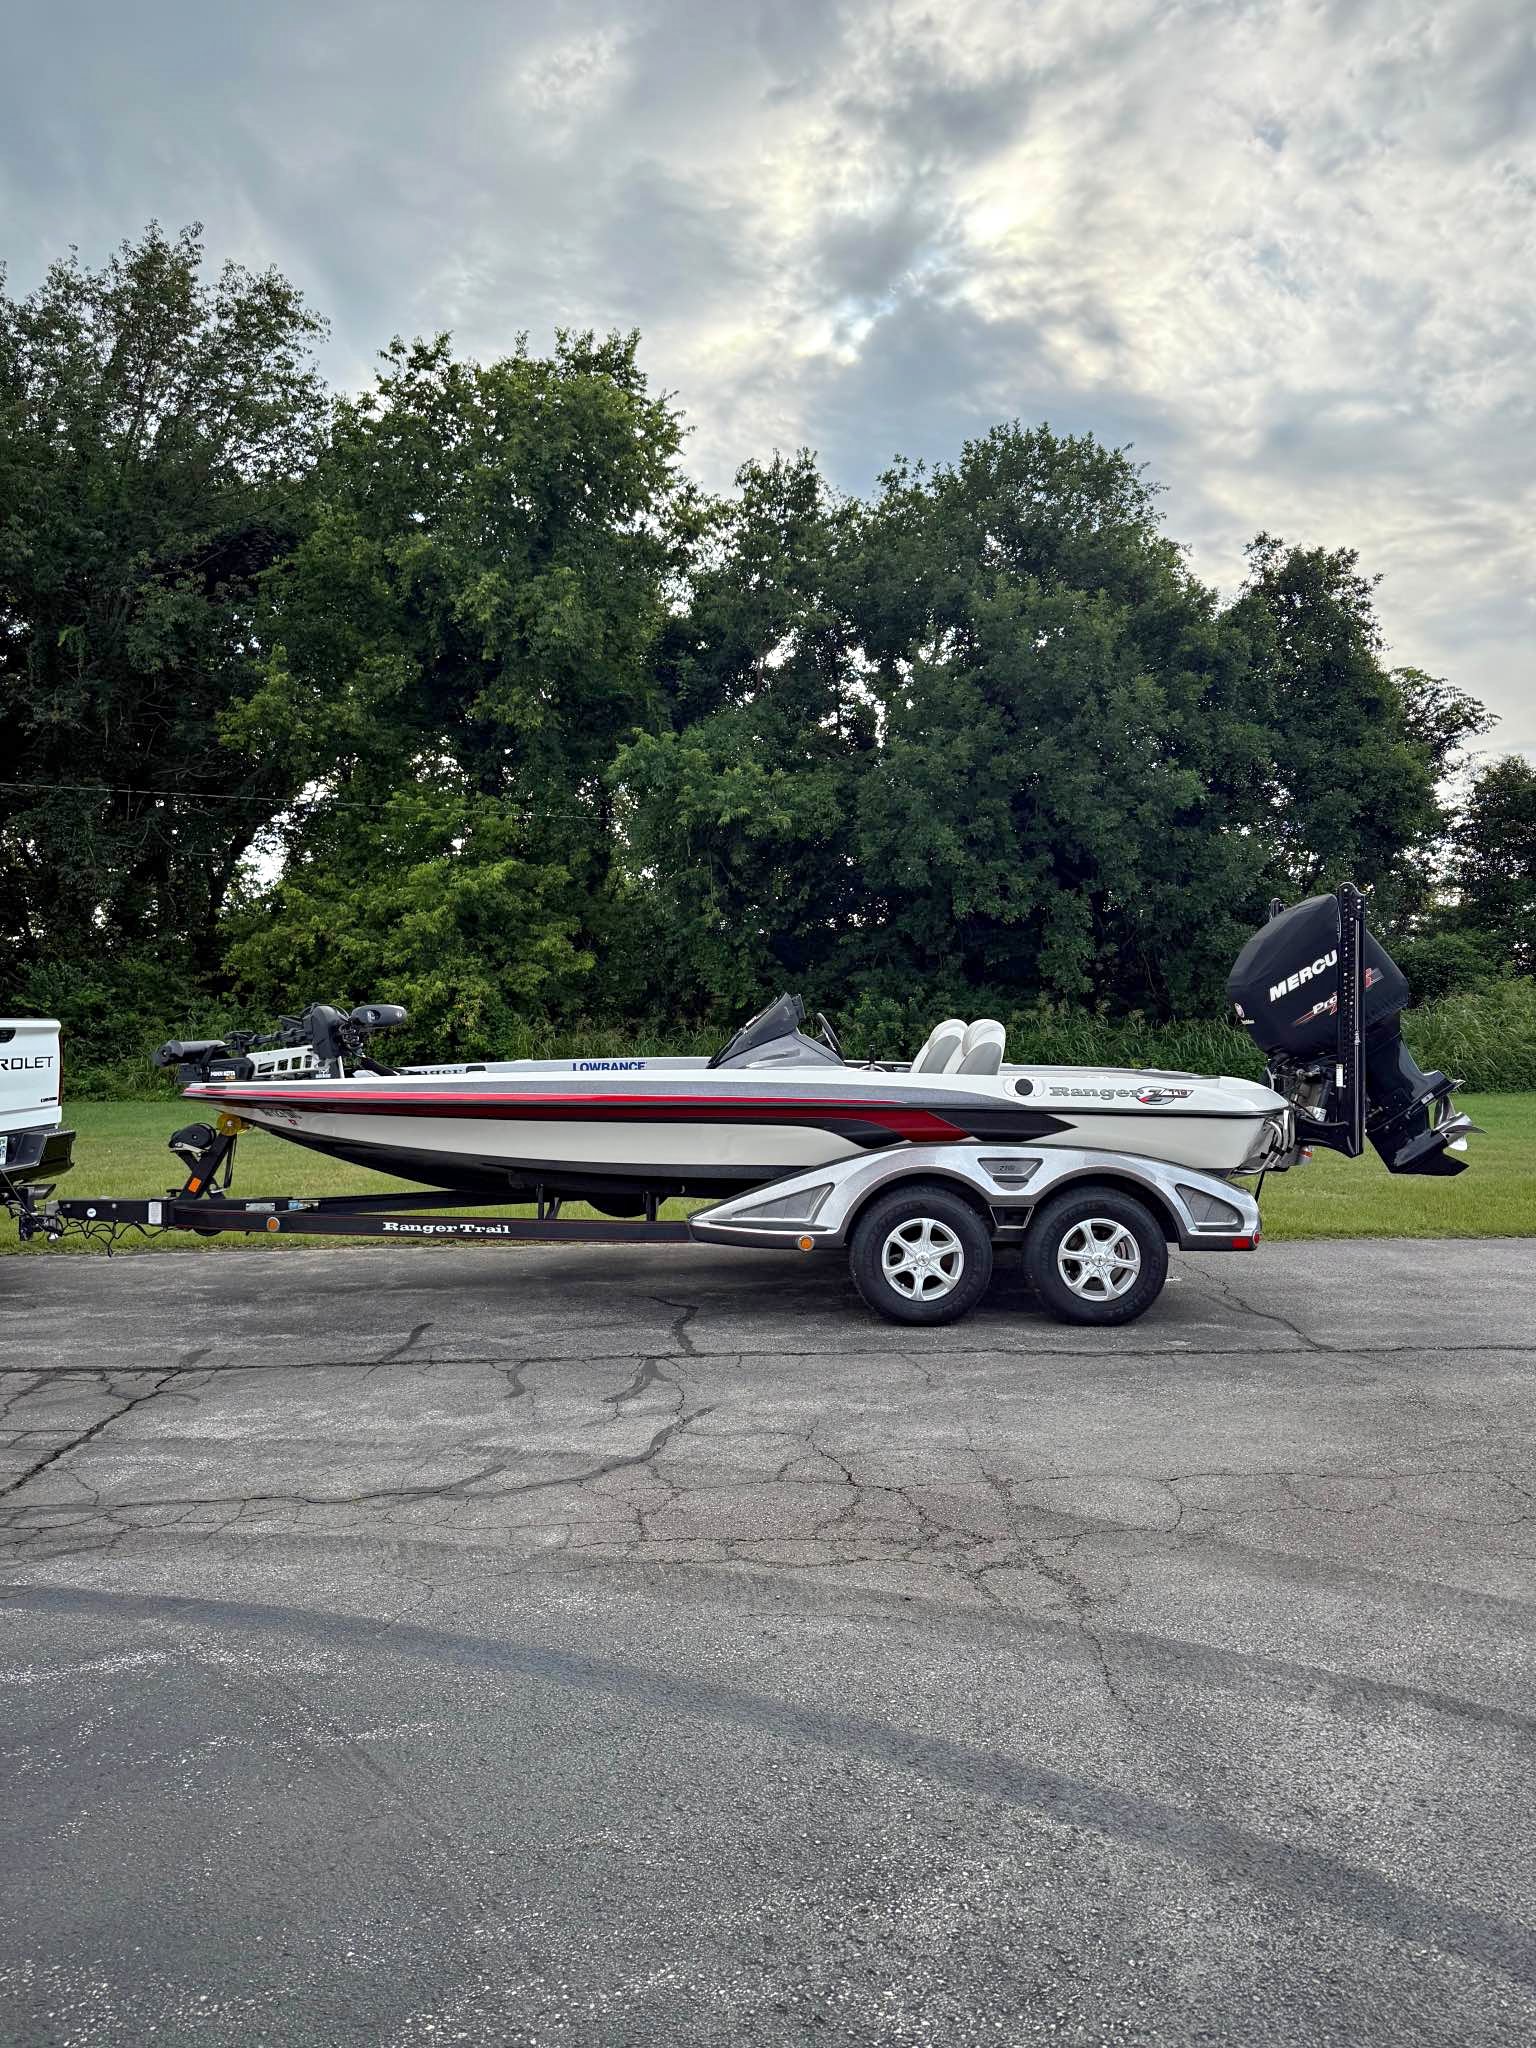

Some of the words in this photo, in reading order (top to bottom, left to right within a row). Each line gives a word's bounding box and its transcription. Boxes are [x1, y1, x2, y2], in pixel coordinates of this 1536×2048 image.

[1269, 950, 1338, 1002] MERCU
[1049, 1086, 1144, 1100] Ranger
[382, 1221, 457, 1234] Ranger
[460, 1224, 511, 1234] Trail
